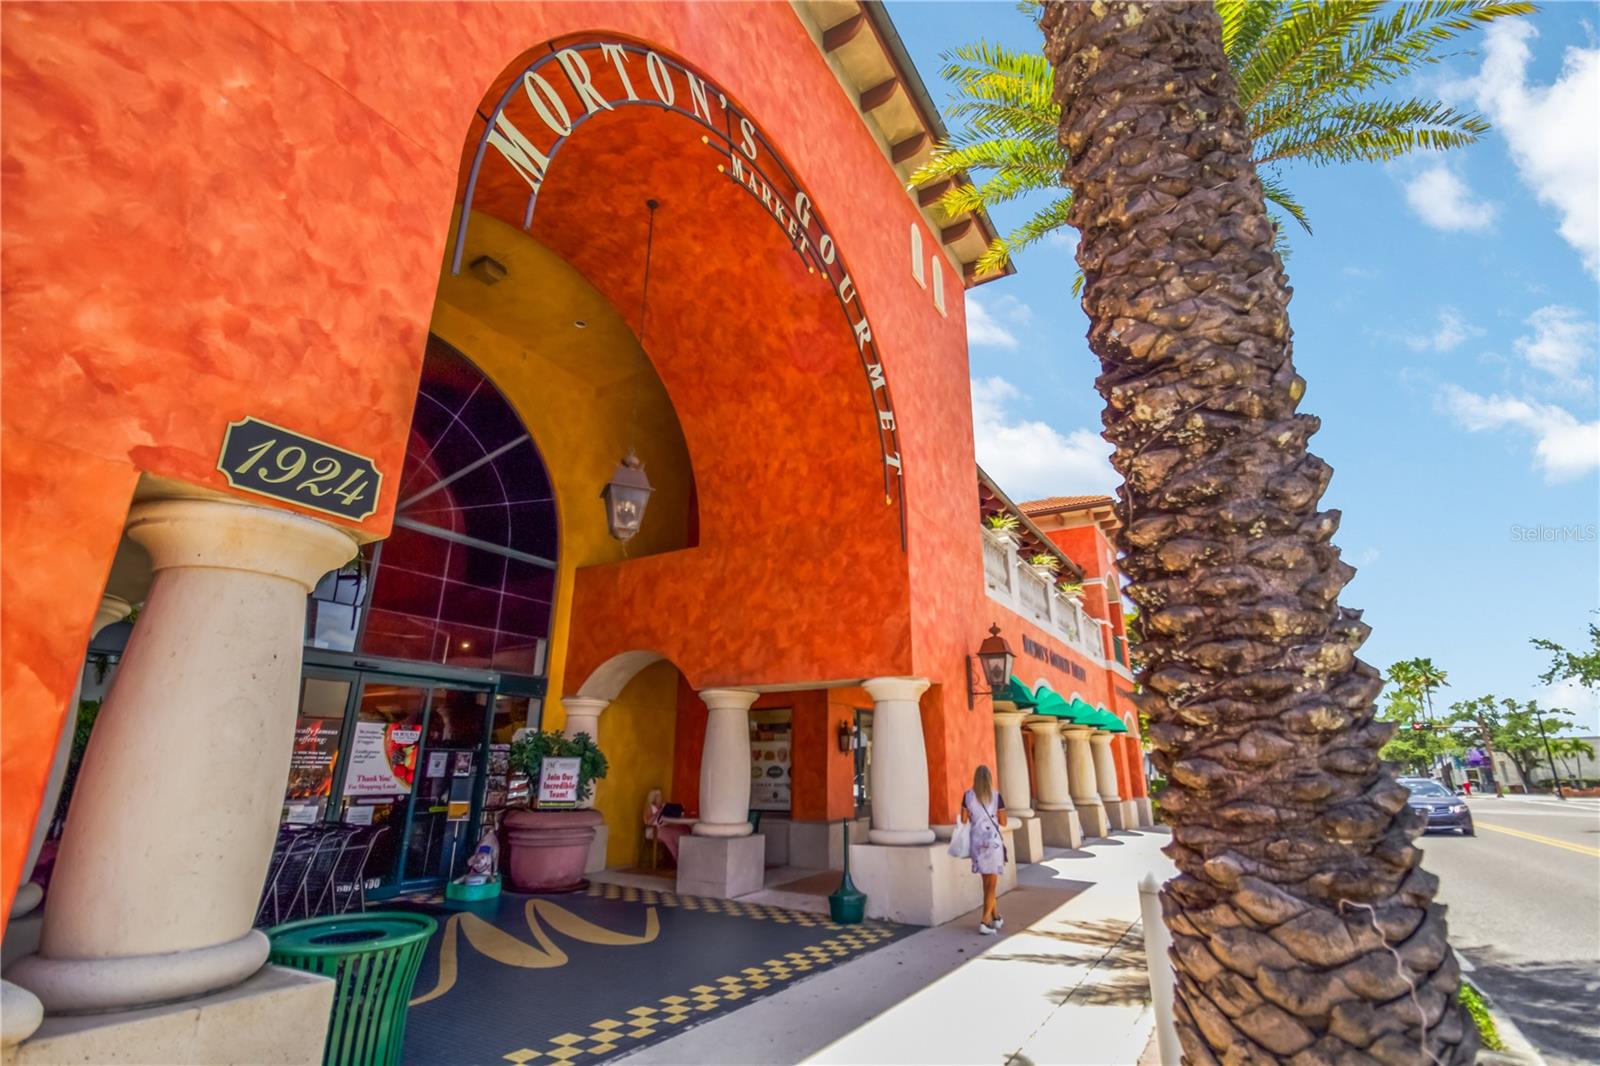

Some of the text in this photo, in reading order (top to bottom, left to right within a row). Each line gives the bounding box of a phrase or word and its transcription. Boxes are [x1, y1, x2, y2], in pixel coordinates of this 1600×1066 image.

[731, 153, 810, 253] MARKET
[486, 42, 903, 476] MORTON'S GOURMET
[235, 439, 369, 506] 1924
[357, 774, 379, 783] Thank
[547, 772, 574, 781] Join Our
[359, 783, 382, 791] Shopping
[543, 781, 576, 790] Incredible
[549, 790, 569, 798] Team!
